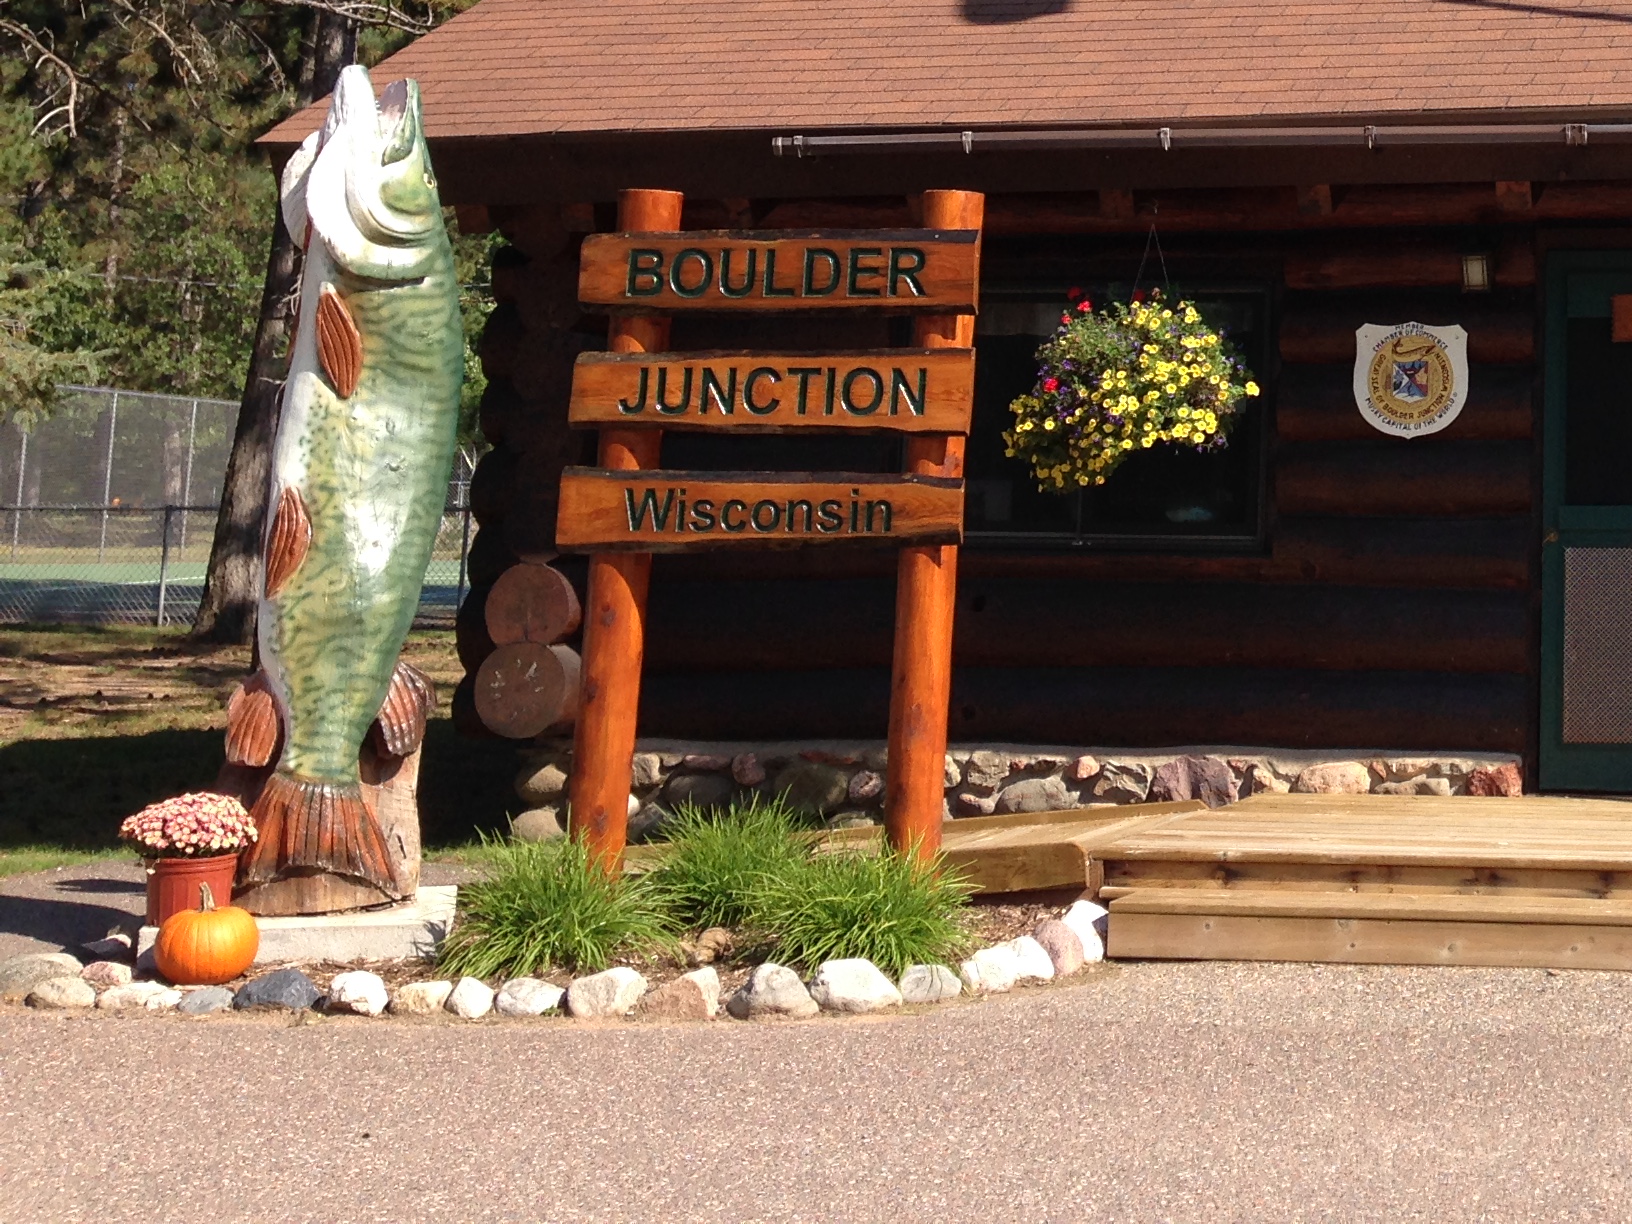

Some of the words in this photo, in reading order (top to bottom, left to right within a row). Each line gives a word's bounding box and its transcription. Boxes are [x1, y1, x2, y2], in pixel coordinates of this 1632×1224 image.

[625, 247, 927, 298] BOULDER
[1373, 331, 1402, 352] CHAMBER
[1415, 330, 1448, 350] COMMERCE
[618, 367, 928, 417] JUNCTION
[1371, 376, 1380, 394] SEAL
[1382, 403, 1414, 419] BOULDER
[1417, 394, 1445, 418] JUNCTION
[1434, 352, 1450, 392] WISCONSIN
[1365, 397, 1382, 418] MUSKY
[1382, 417, 1412, 430] CAPITAL
[1423, 419, 1437, 427] THE
[1437, 398, 1455, 418] WORLD
[624, 487, 893, 534] Wisconsin
